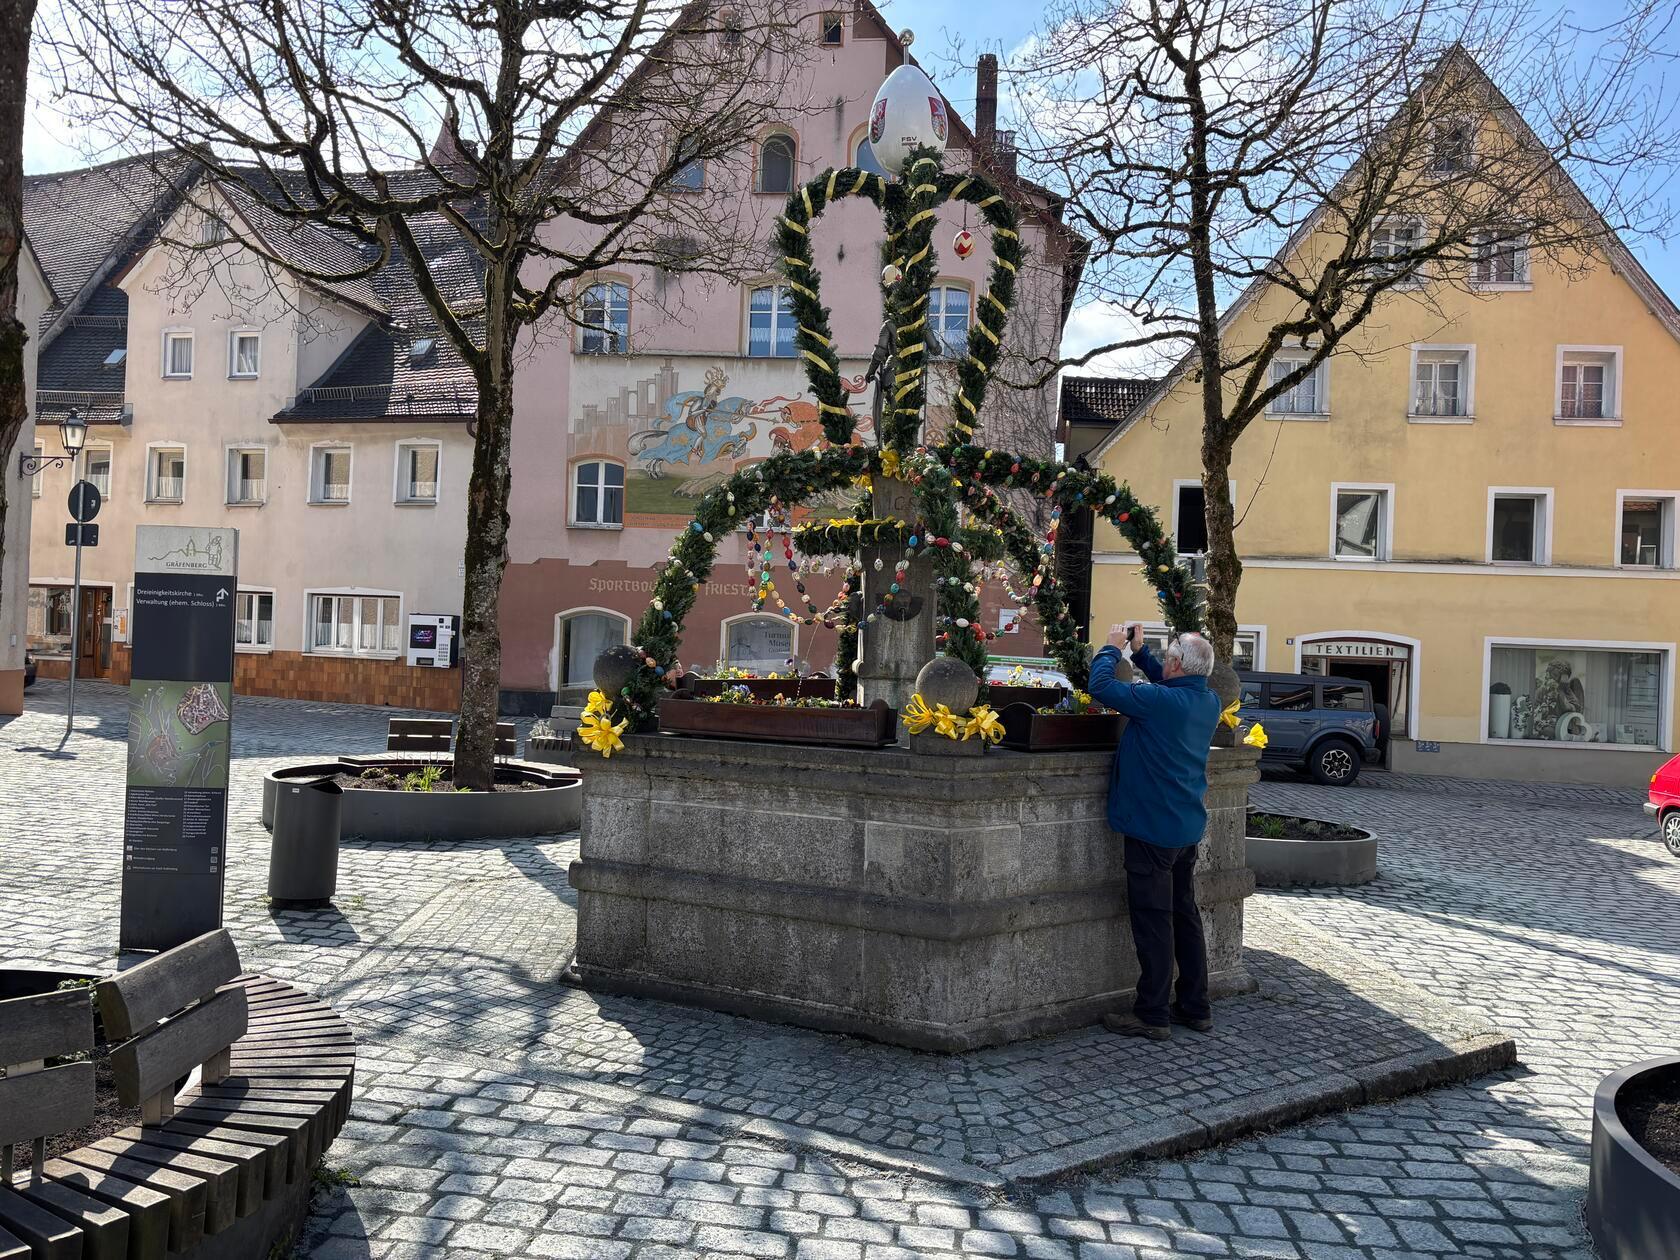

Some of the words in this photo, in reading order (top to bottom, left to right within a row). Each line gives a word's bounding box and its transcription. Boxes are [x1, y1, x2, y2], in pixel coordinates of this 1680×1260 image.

[137, 589, 192, 597] Dreieinigkeitskirche
[136, 598, 168, 606] Verwaltung
[191, 600, 215, 608] Schloss)
[1316, 645, 1394, 656] TEXTILIEN
